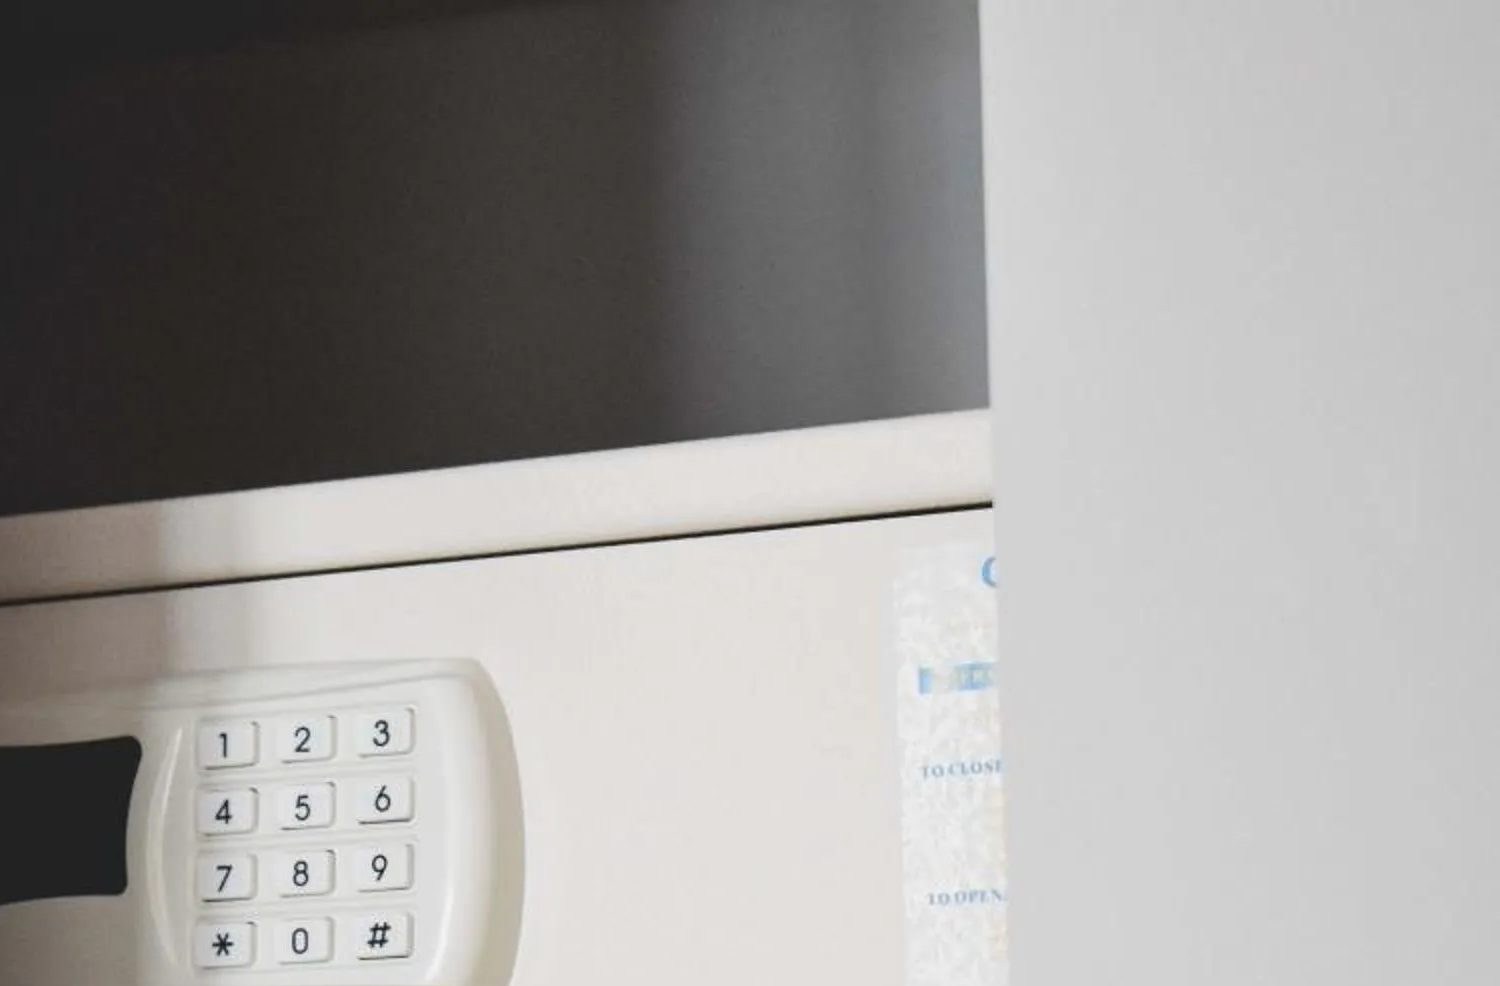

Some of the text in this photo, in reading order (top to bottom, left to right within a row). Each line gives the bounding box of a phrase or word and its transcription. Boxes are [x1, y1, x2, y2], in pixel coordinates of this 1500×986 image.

[218, 720, 390, 758] 1 2 3
[919, 764, 944, 780] TO
[215, 785, 391, 824] 4 5 6
[216, 854, 388, 893] 7 8 9
[291, 928, 309, 954] 0
